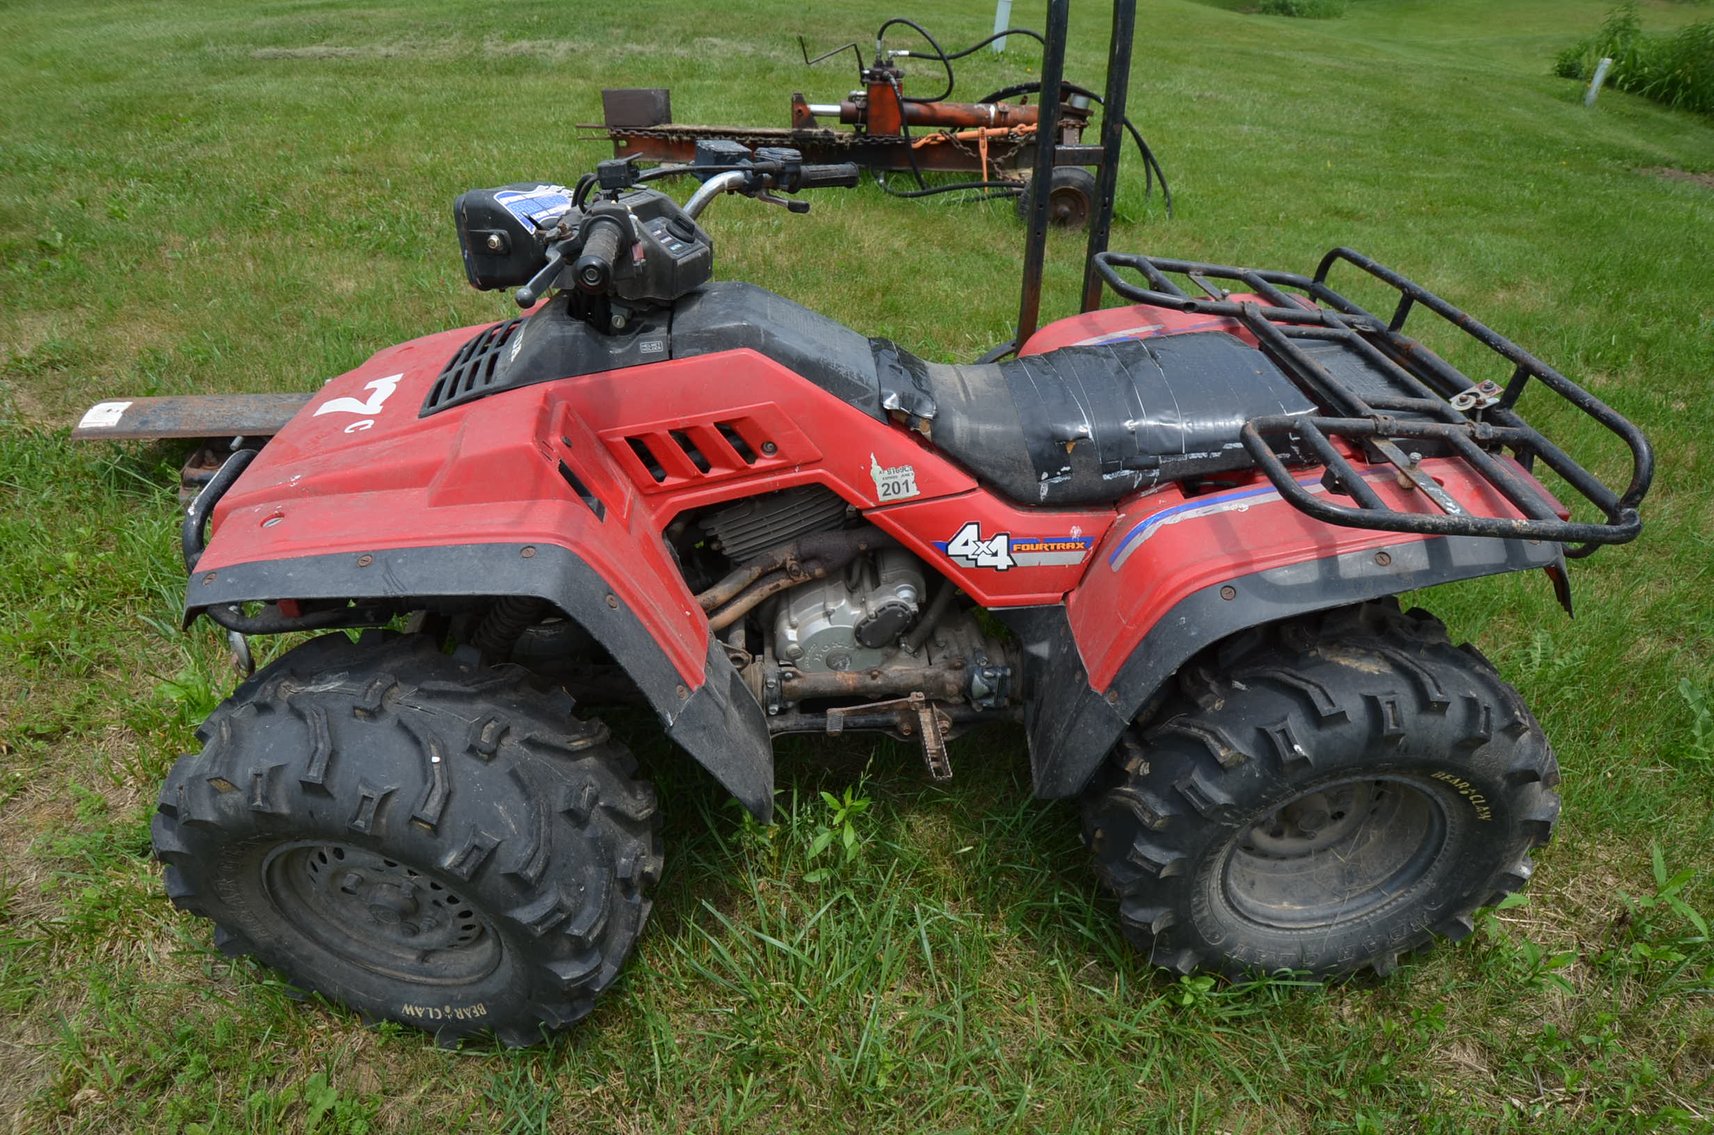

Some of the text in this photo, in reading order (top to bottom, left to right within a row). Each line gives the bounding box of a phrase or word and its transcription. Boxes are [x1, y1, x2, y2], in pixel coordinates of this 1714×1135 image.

[1013, 542, 1086, 552] FOURTRAX
[1430, 771, 1492, 821] BEAR CLAW
[401, 1003, 488, 1020] BEAR CLAW
